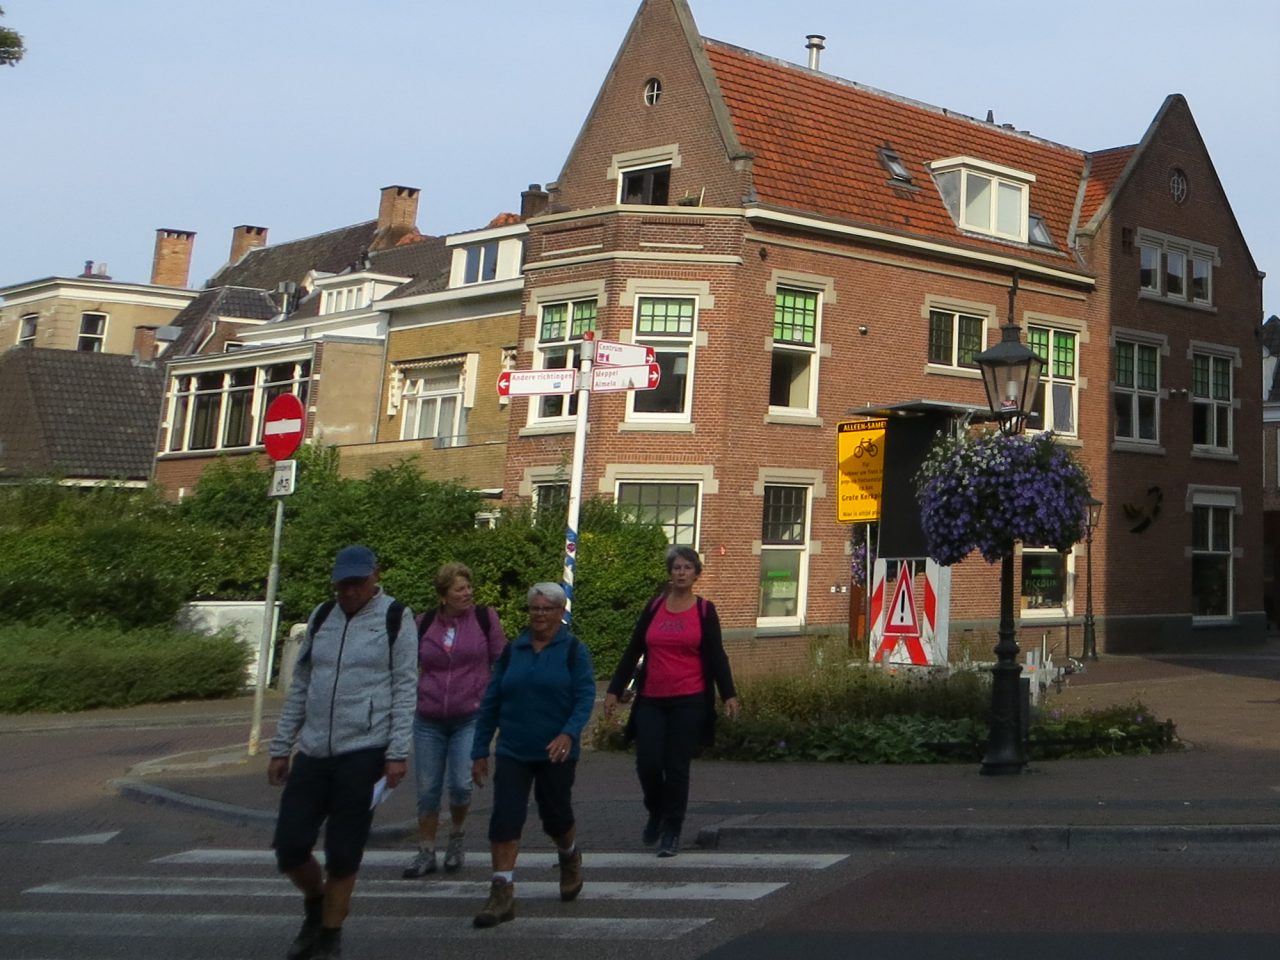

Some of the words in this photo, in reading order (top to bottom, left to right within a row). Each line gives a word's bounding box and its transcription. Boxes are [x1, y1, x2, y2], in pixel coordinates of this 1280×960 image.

[599, 343, 623, 352] Centrum
[537, 373, 573, 381] richtingen
[595, 370, 618, 378] Meppel
[843, 421, 887, 431] ALLEEN-SAME
